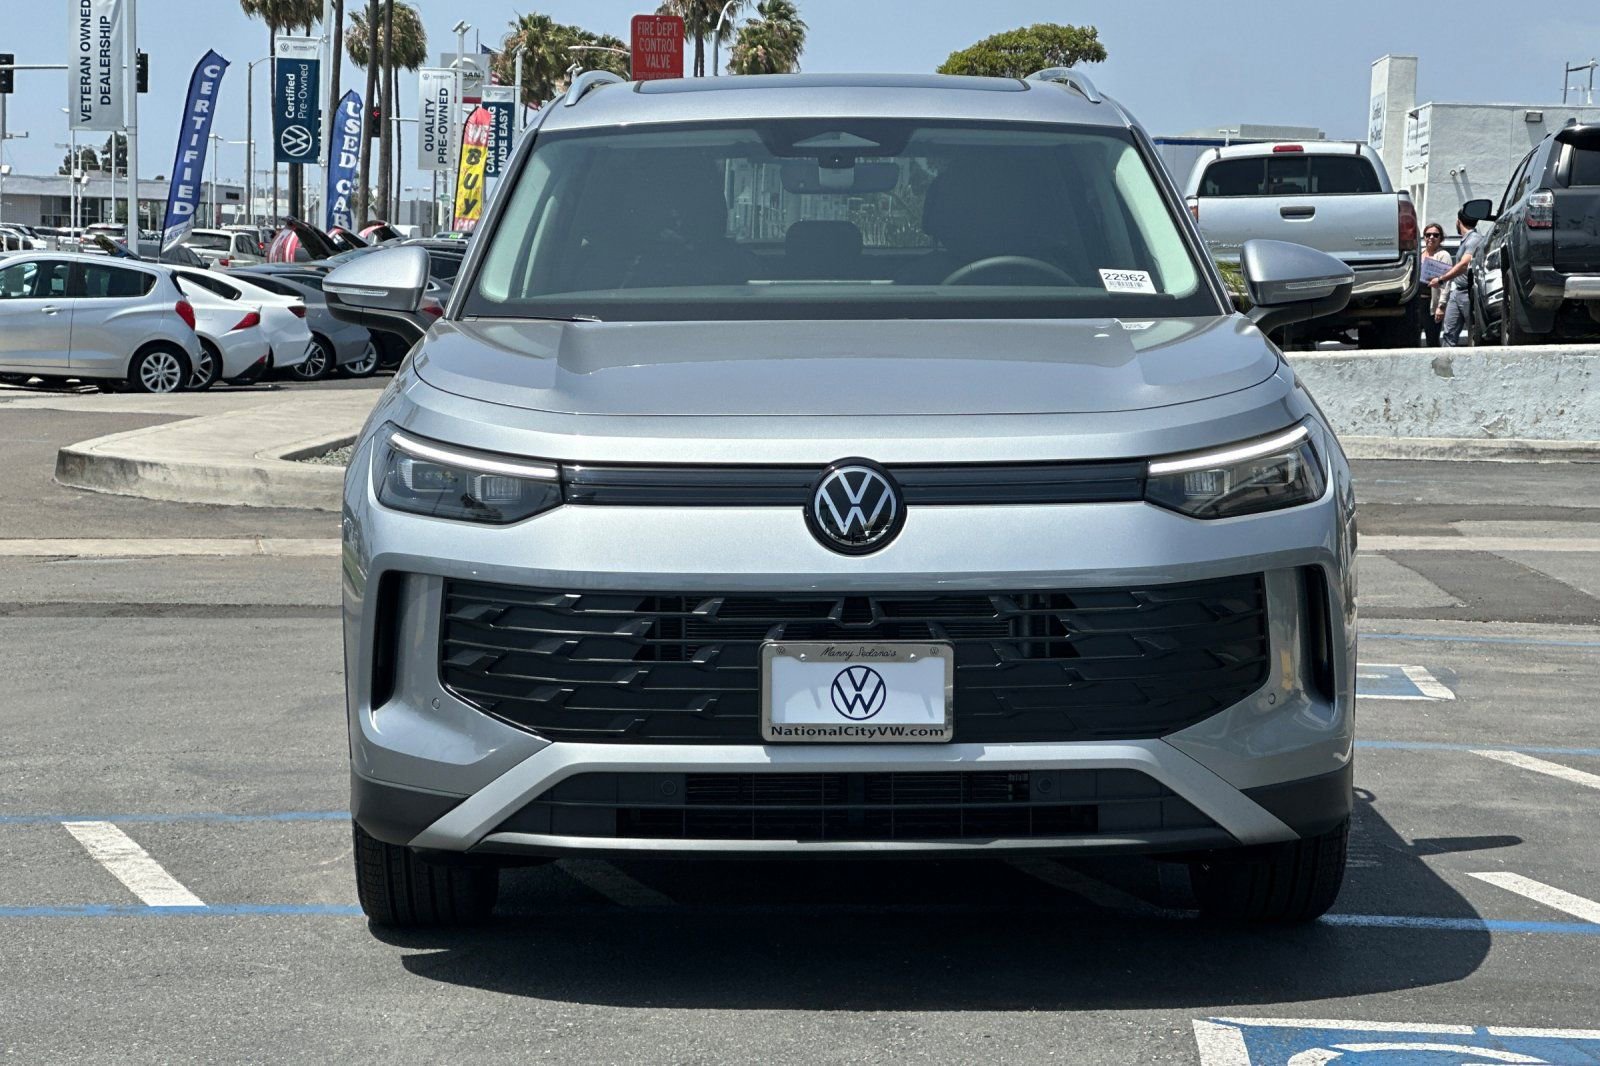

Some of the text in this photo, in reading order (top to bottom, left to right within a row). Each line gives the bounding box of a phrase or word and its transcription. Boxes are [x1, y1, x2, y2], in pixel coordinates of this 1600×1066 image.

[637, 21, 655, 36] FIRE
[638, 37, 678, 53] CONTROL
[80, 0, 92, 122] VETERAN OWNED
[100, 16, 111, 105] DEALERSHIP
[645, 53, 671, 69] VALVE
[285, 73, 295, 118] Certified
[298, 64, 309, 119] Pre-Owned
[173, 64, 221, 215] CERTIFIED
[338, 101, 360, 169] USED
[424, 98, 435, 152] QUALITY
[438, 88, 448, 164] PRE-OWNED
[487, 106, 496, 173] CAR BUYING
[499, 108, 508, 136] EASY
[463, 148, 482, 215] BUY
[1103, 273, 1147, 282] 22962
[771, 725, 944, 739] NationalCityVW.com
